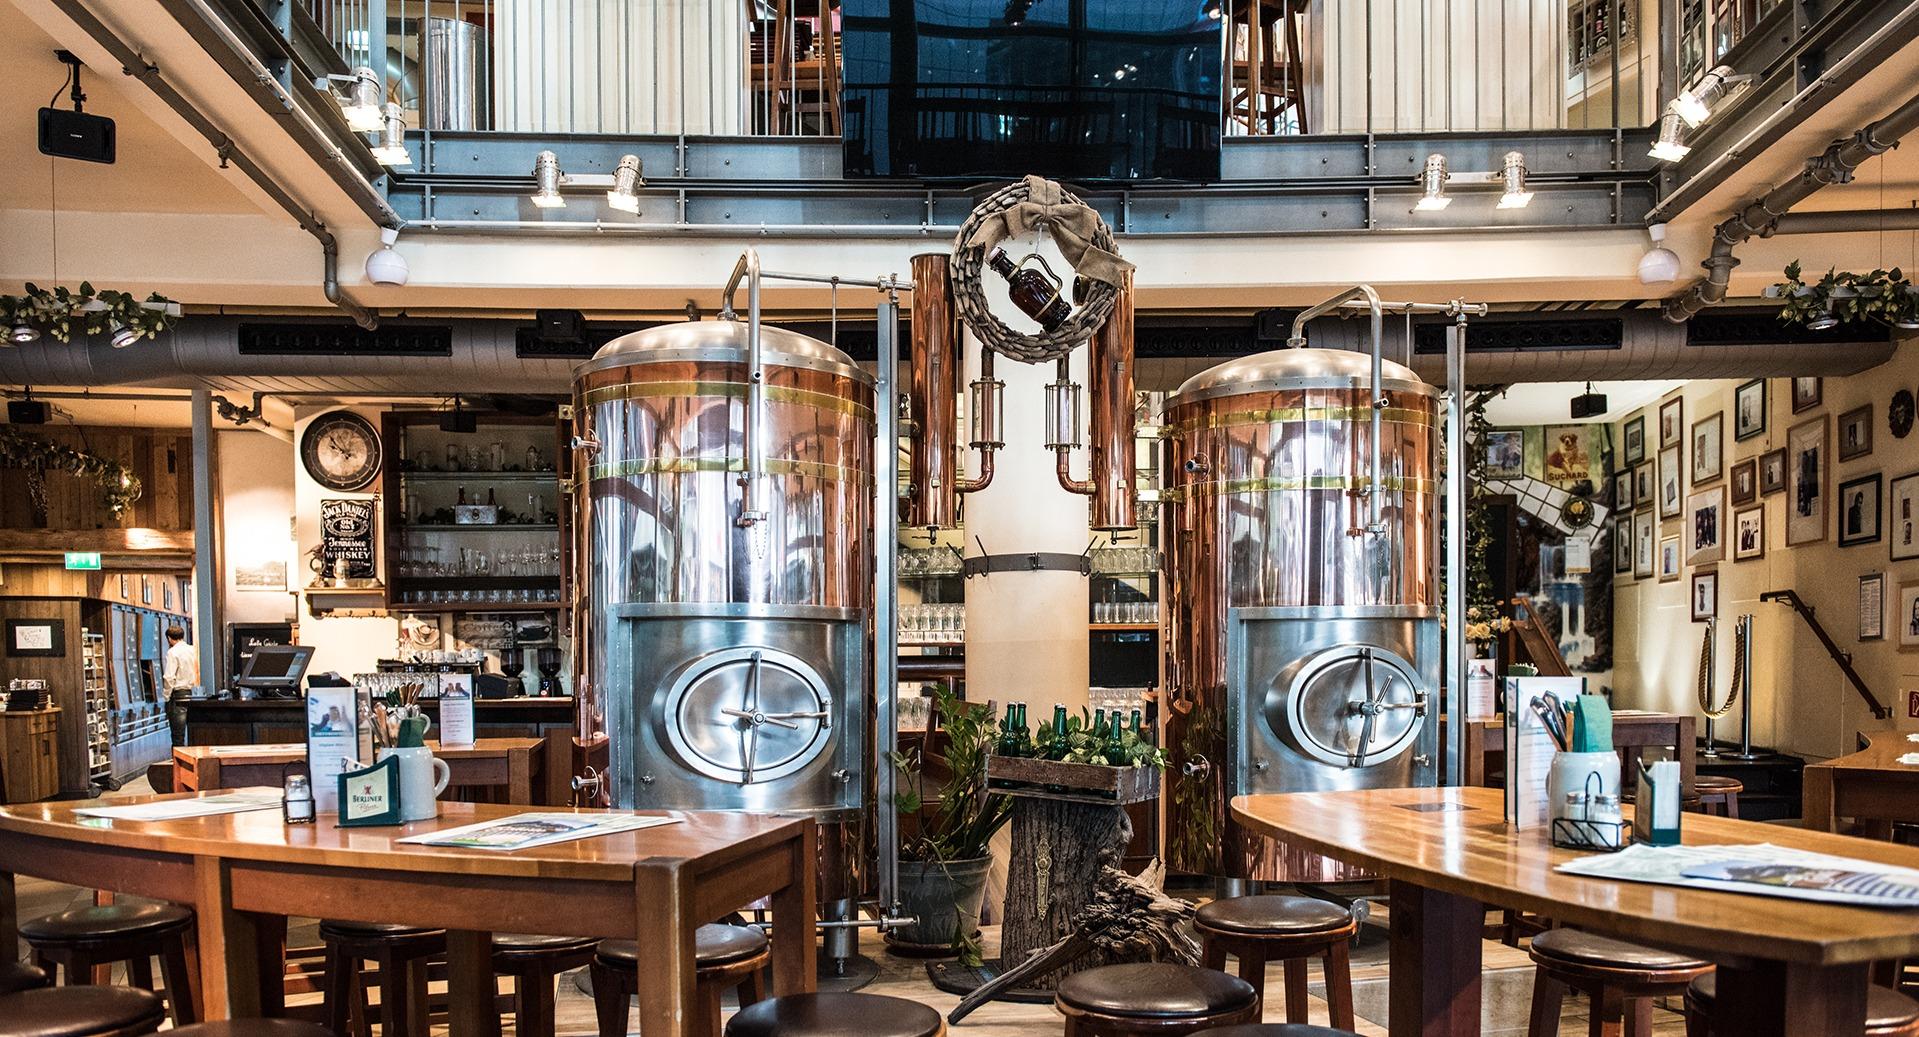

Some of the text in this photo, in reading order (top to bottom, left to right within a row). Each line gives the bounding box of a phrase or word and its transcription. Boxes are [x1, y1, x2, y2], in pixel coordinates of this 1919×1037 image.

[1548, 472, 1588, 481] SUCHARD
[323, 502, 369, 519] JACK DANIEL'S
[328, 537, 367, 547] Tennessee
[325, 551, 371, 559] WHISKEY
[353, 795, 382, 803] BERLINER
